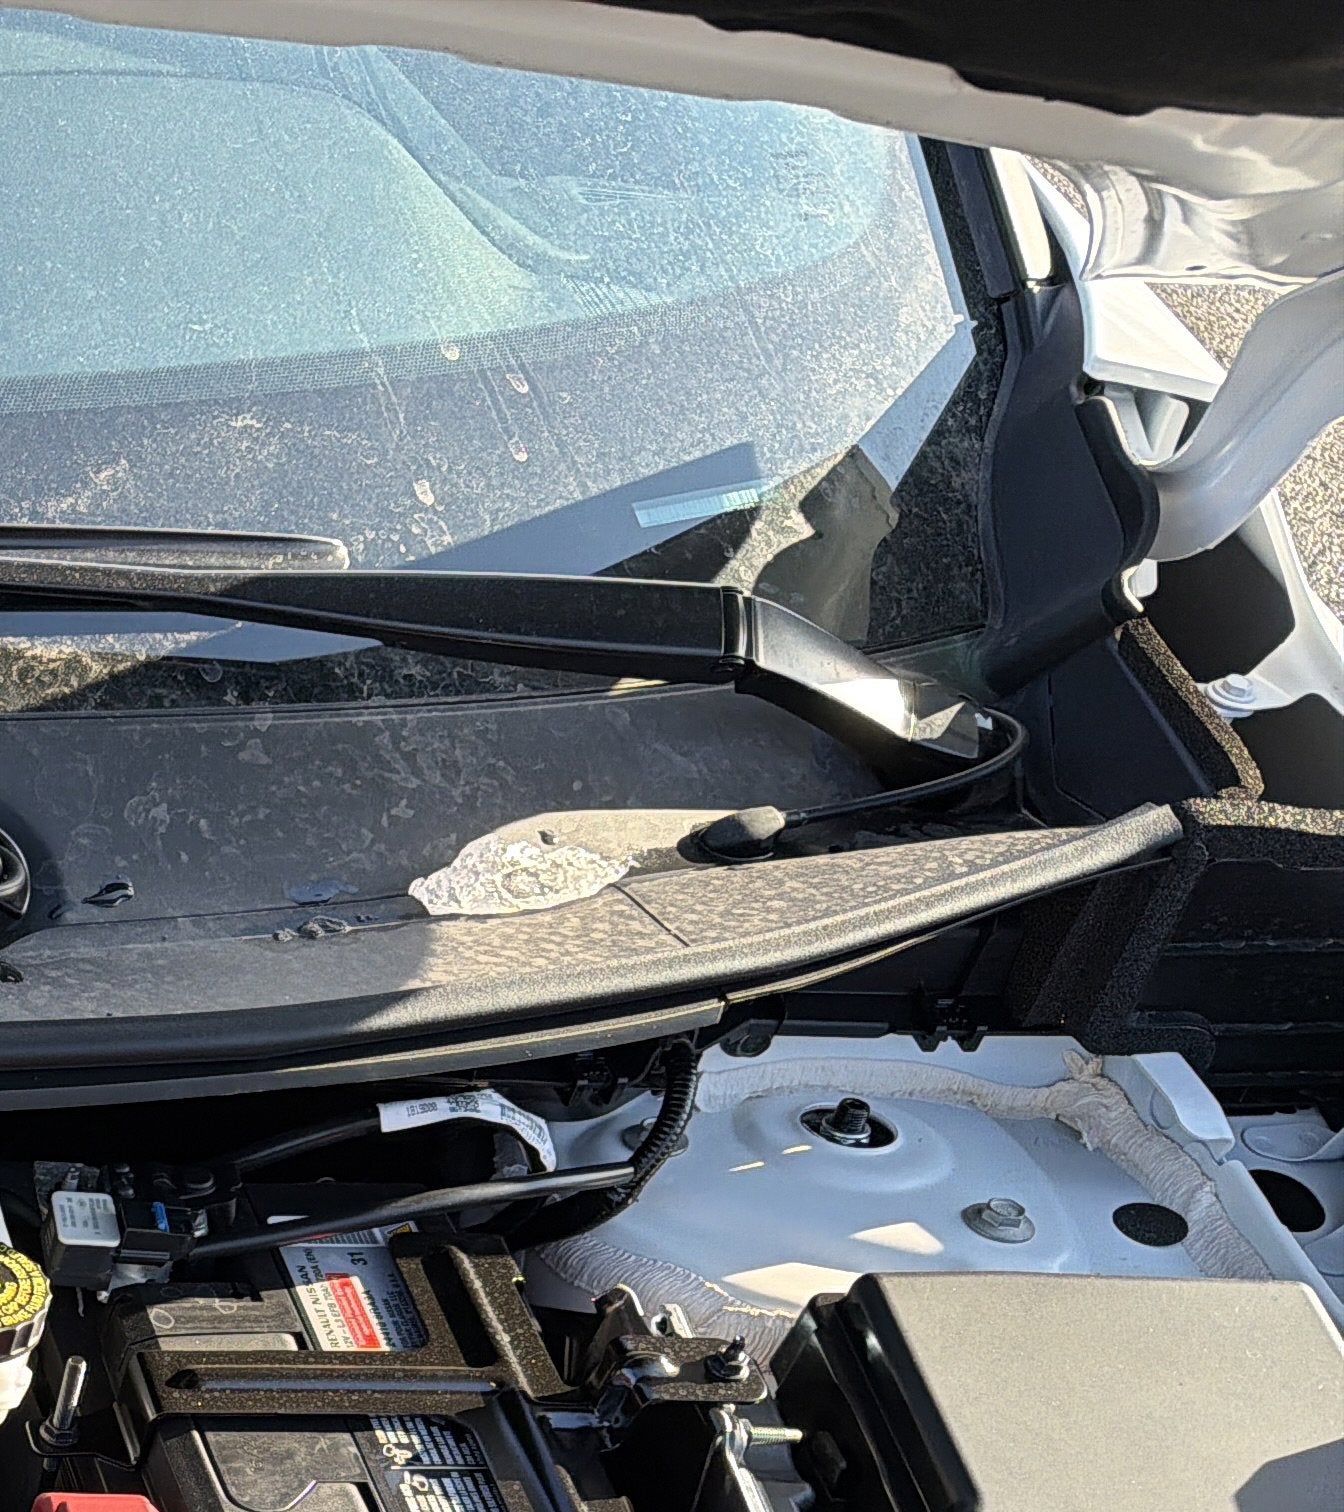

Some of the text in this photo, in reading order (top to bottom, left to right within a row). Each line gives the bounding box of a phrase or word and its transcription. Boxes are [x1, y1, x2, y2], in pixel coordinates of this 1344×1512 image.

[347, 1251, 368, 1267] 31
[296, 1265, 341, 1349] RENAULT NISSAN
